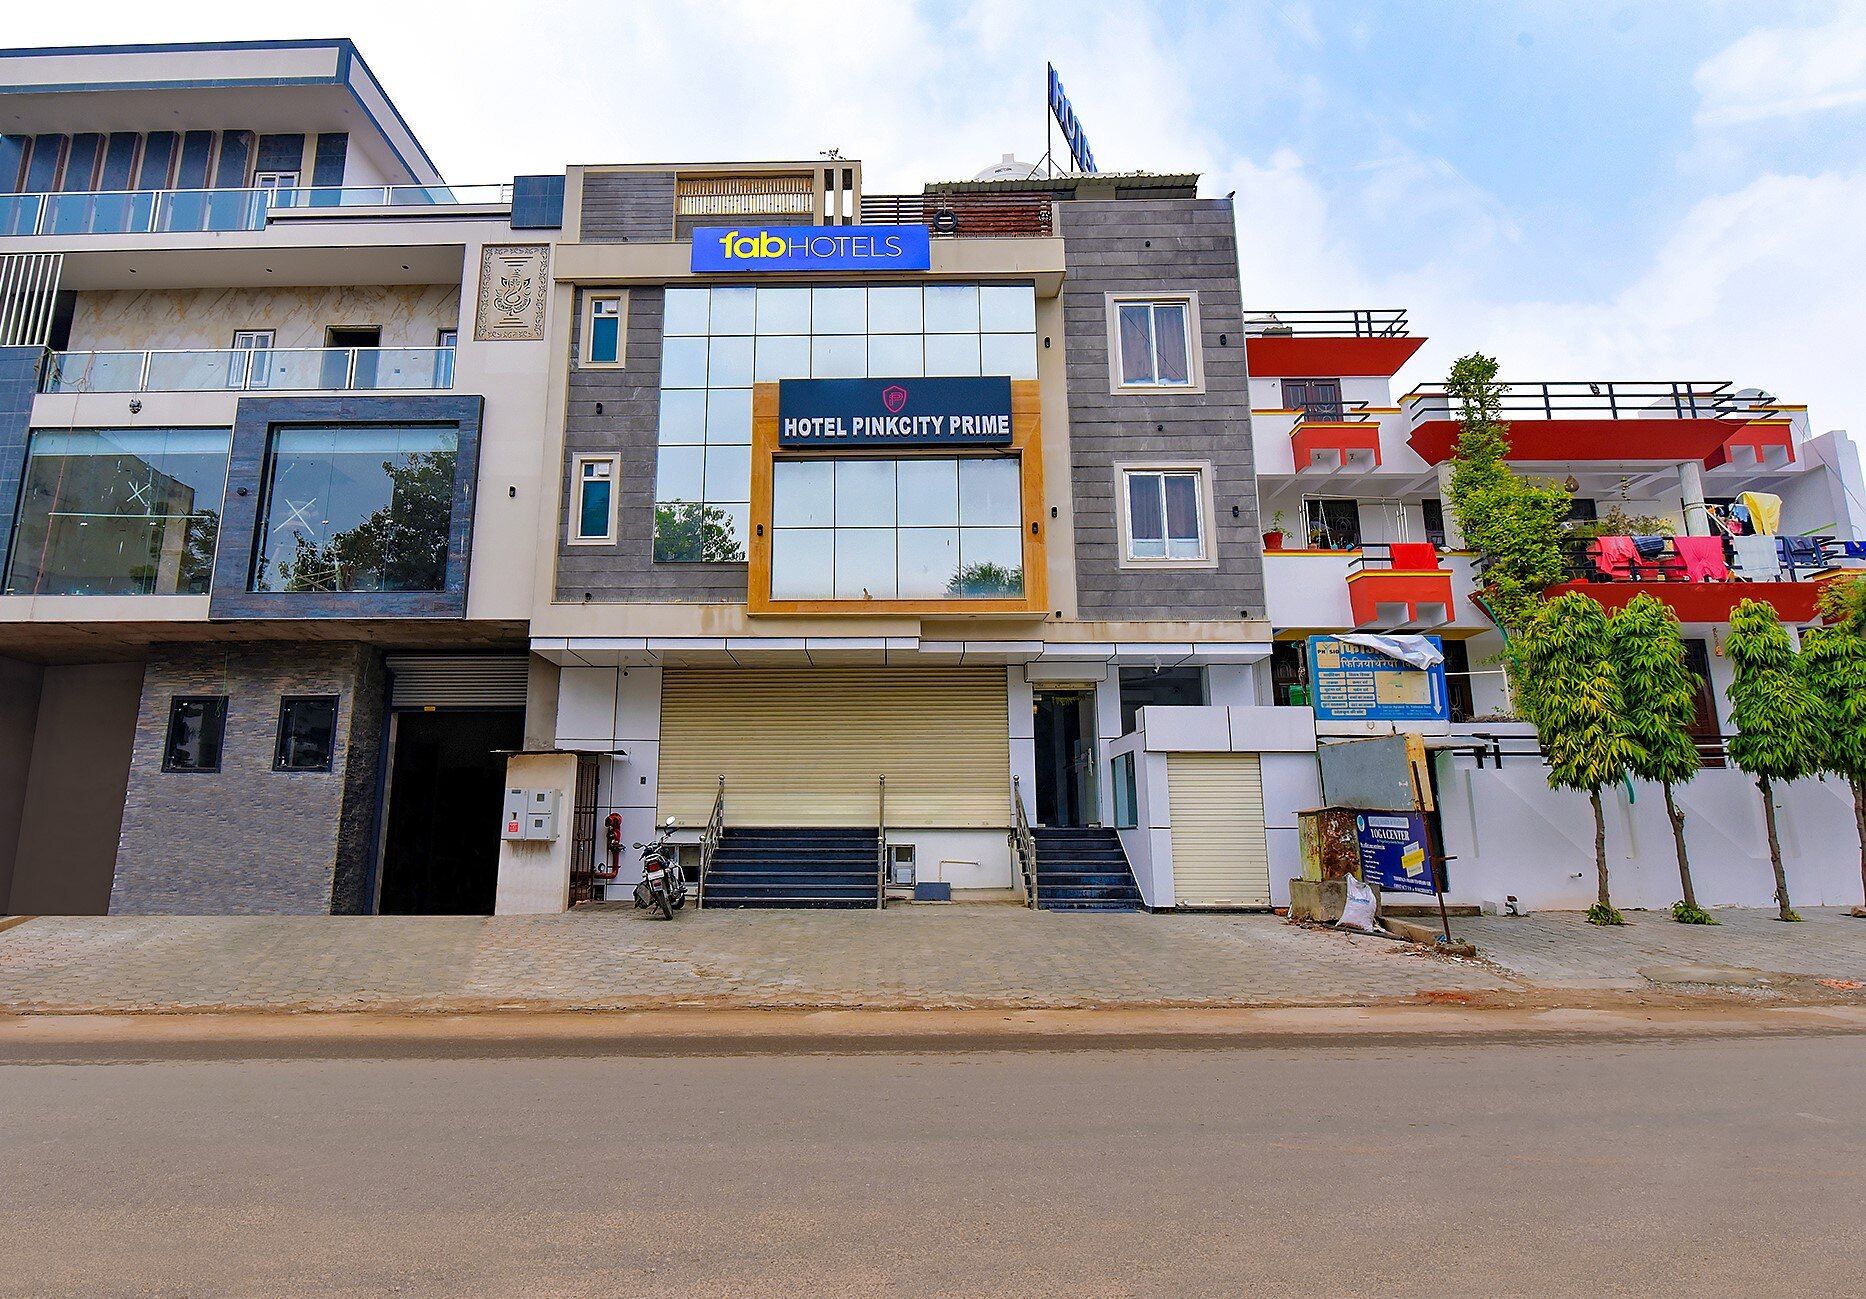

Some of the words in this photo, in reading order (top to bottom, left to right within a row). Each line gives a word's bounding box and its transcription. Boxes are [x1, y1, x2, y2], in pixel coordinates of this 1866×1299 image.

[719, 231, 902, 258] fabHOTELS
[784, 417, 847, 436] HOTEL
[852, 416, 944, 436] PINKCITY
[949, 415, 1010, 435] PRIME
